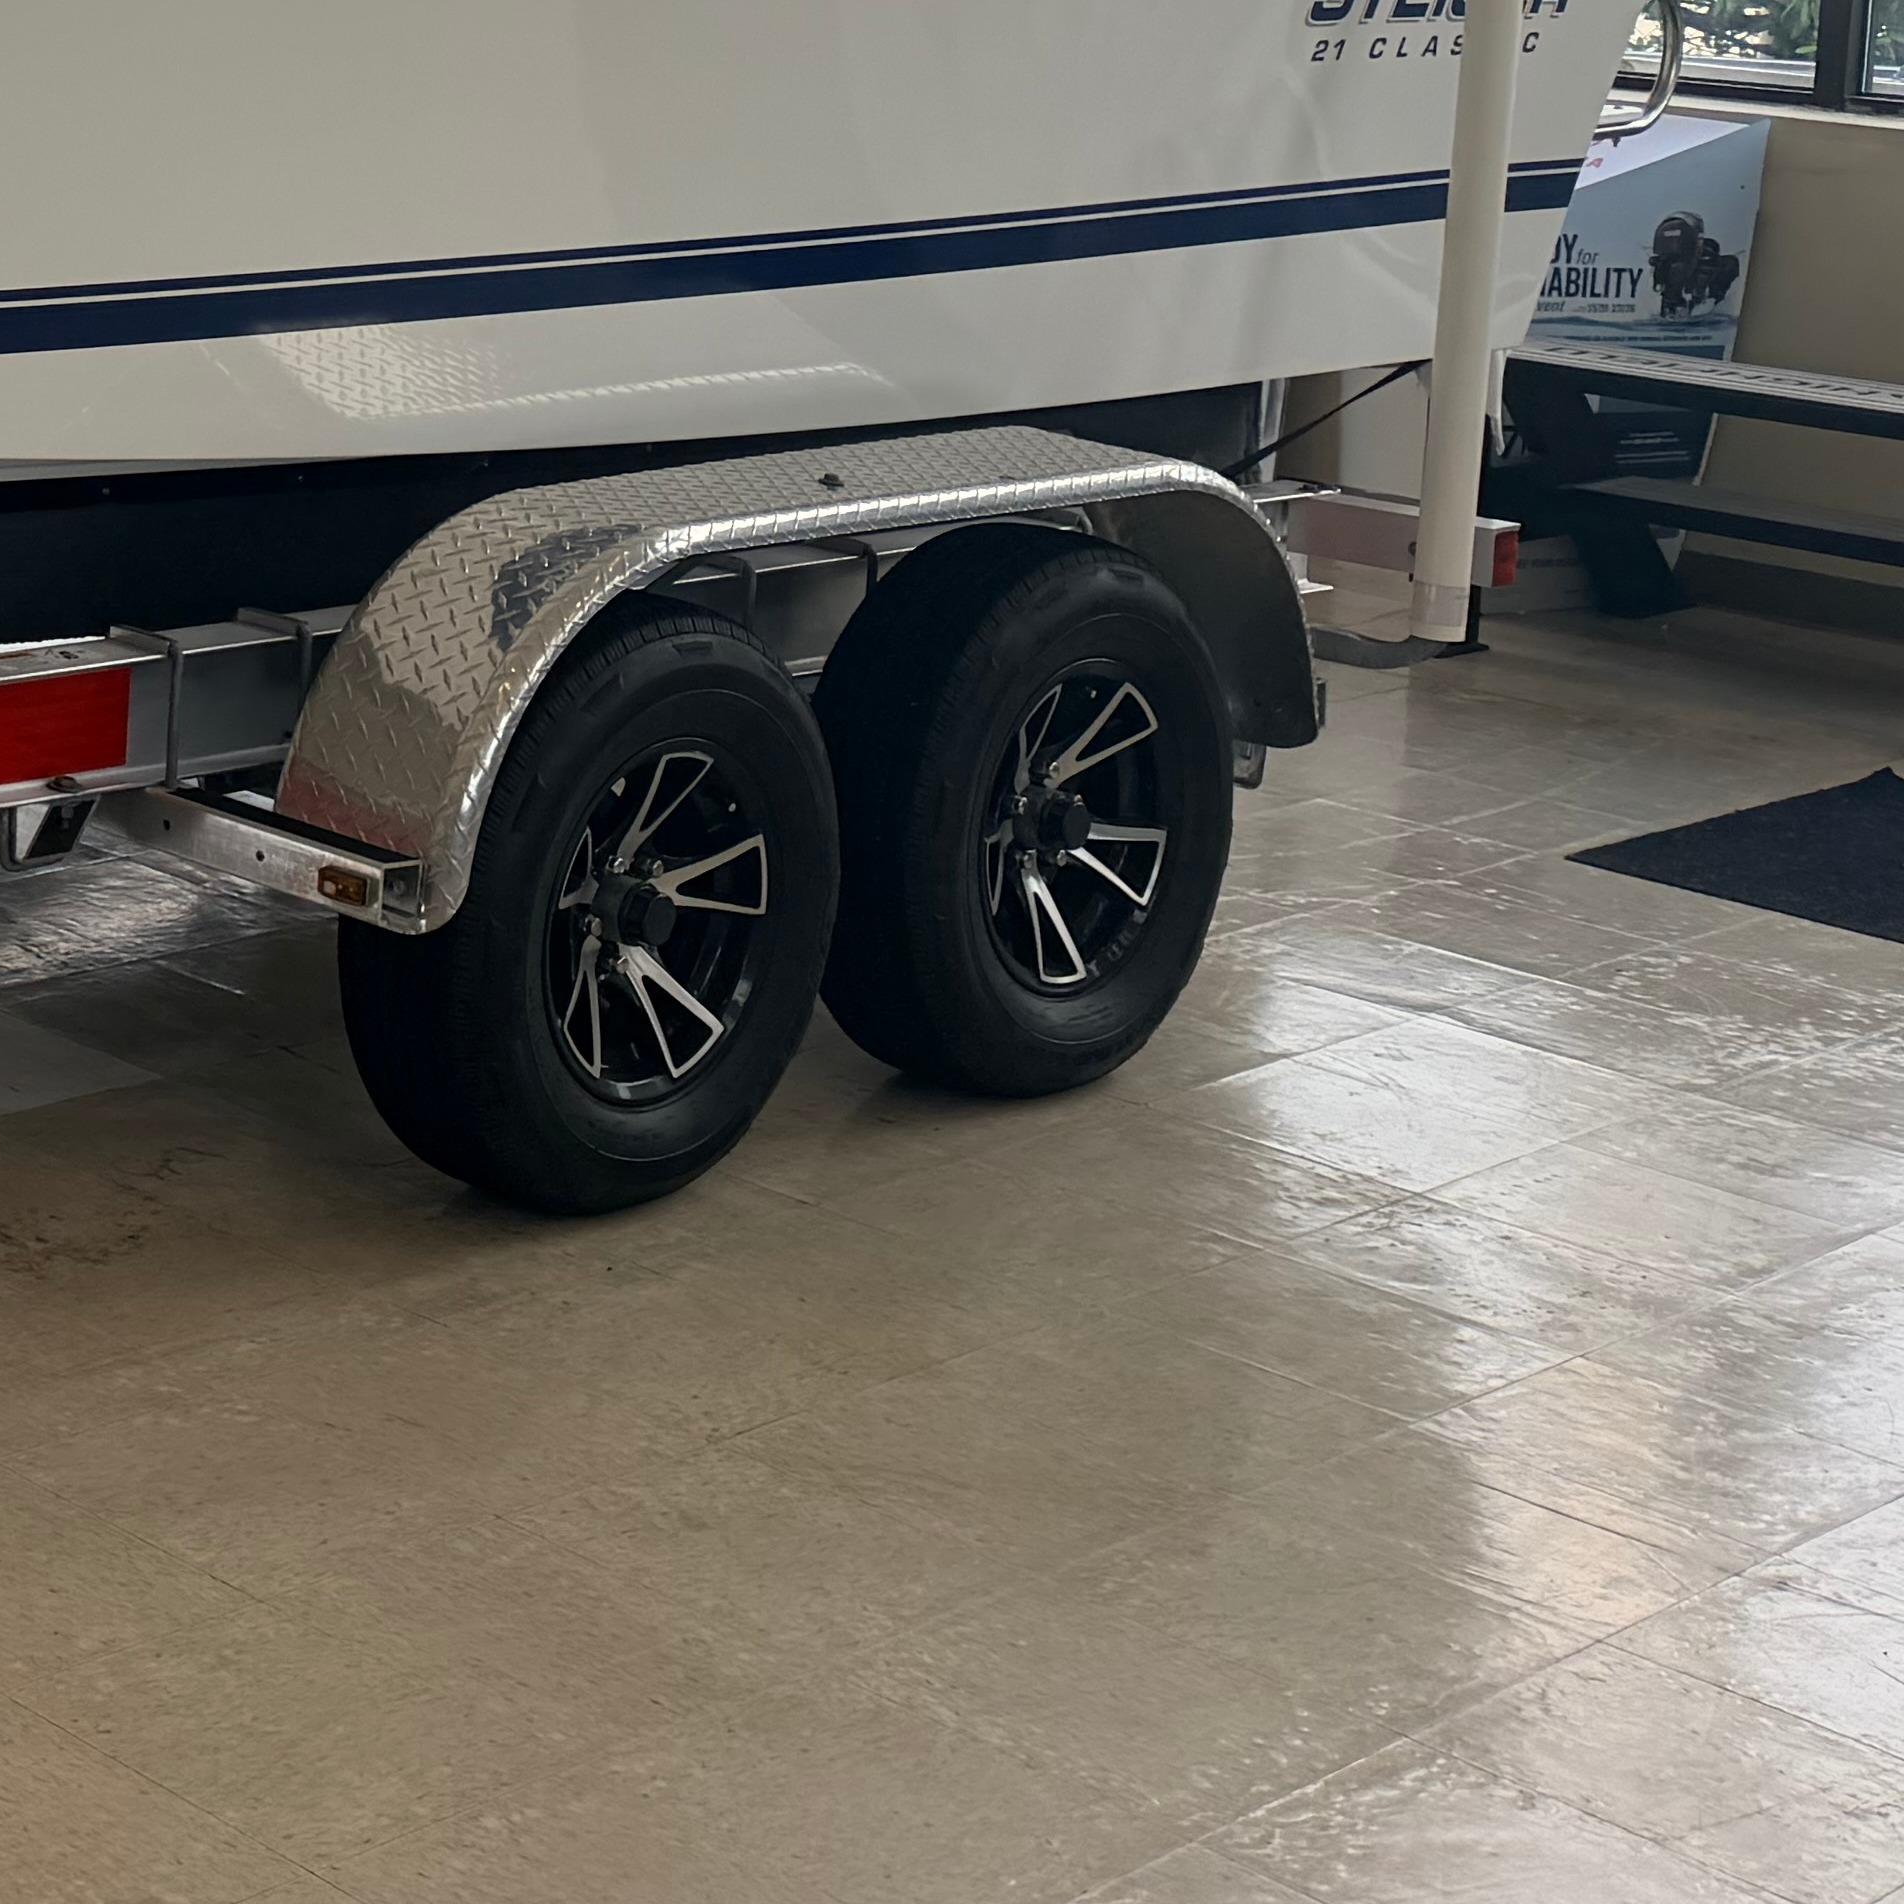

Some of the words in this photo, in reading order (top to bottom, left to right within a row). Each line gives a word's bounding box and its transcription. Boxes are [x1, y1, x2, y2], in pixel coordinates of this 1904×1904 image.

[1310, 38, 1346, 62] 21
[1368, 31, 1540, 59] CLASC
[1576, 248, 1599, 265] for
